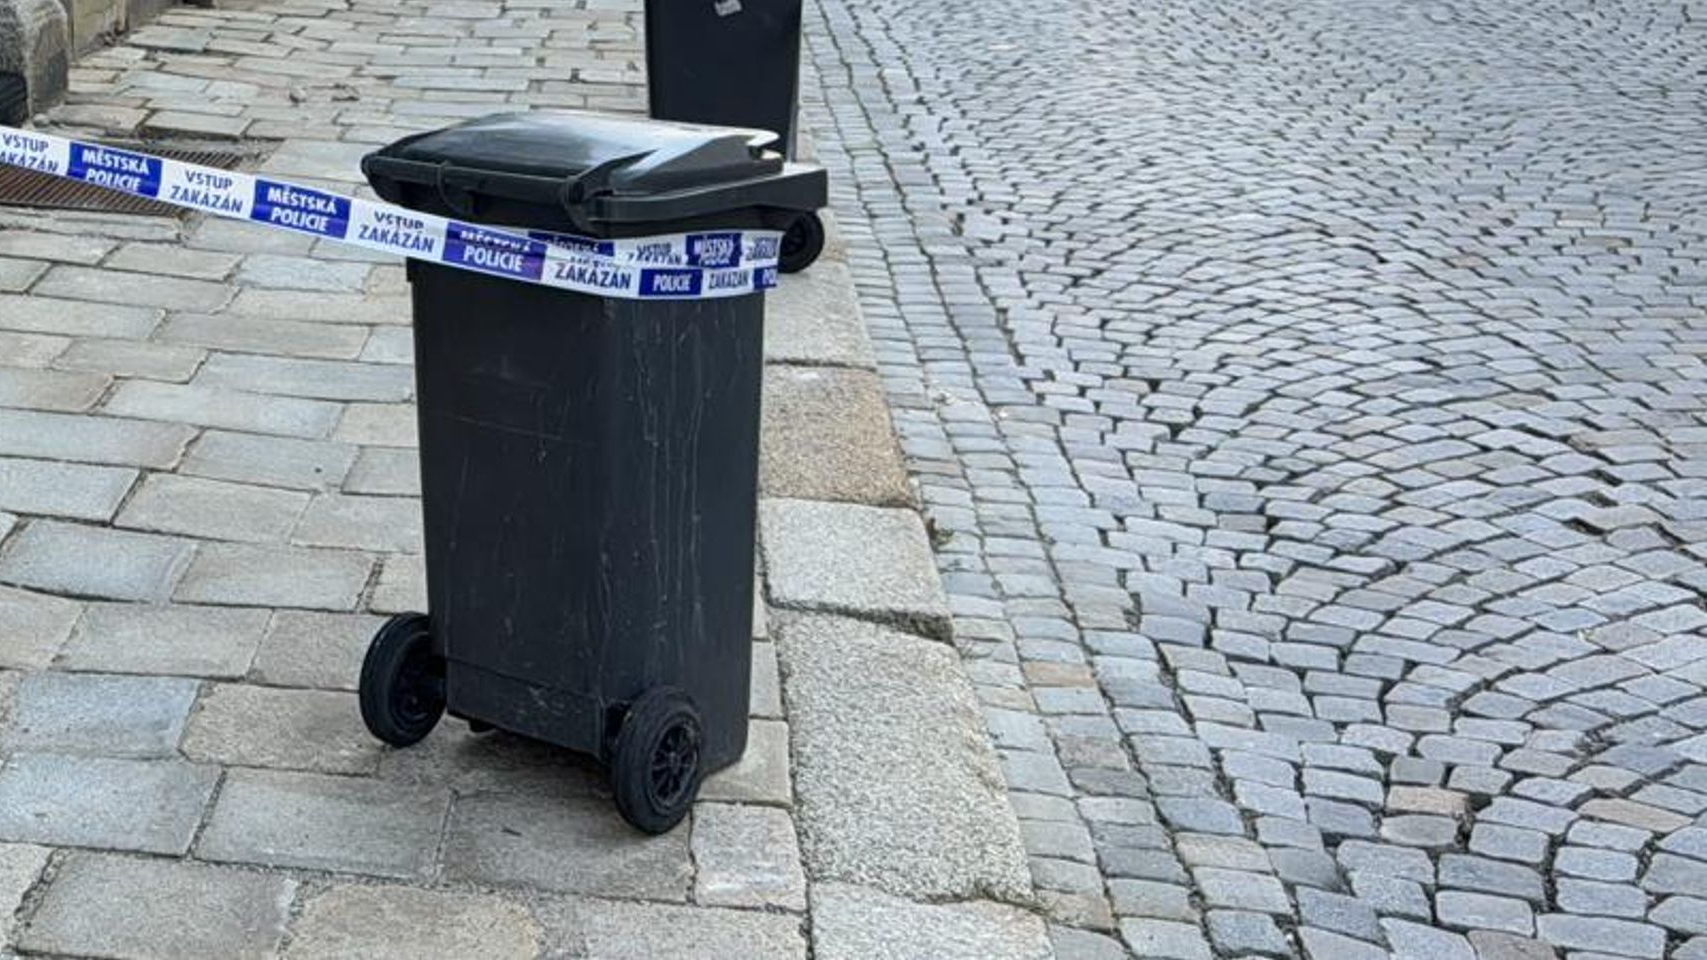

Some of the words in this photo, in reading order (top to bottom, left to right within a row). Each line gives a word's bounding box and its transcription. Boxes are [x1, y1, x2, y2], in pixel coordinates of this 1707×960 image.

[3, 133, 49, 153] VSTUP
[82, 148, 150, 176] MĚSTSKÁ
[85, 167, 142, 191] POLICIE
[185, 170, 233, 190] VSTUP
[170, 184, 244, 213] ZAKÁZÁN
[267, 187, 337, 215] MĚSTSKÁ
[271, 207, 329, 232] POLICIE
[358, 224, 435, 253] ZAKÁZÁN
[463, 246, 525, 272] POLICIE
[653, 274, 692, 292] POLICIE
